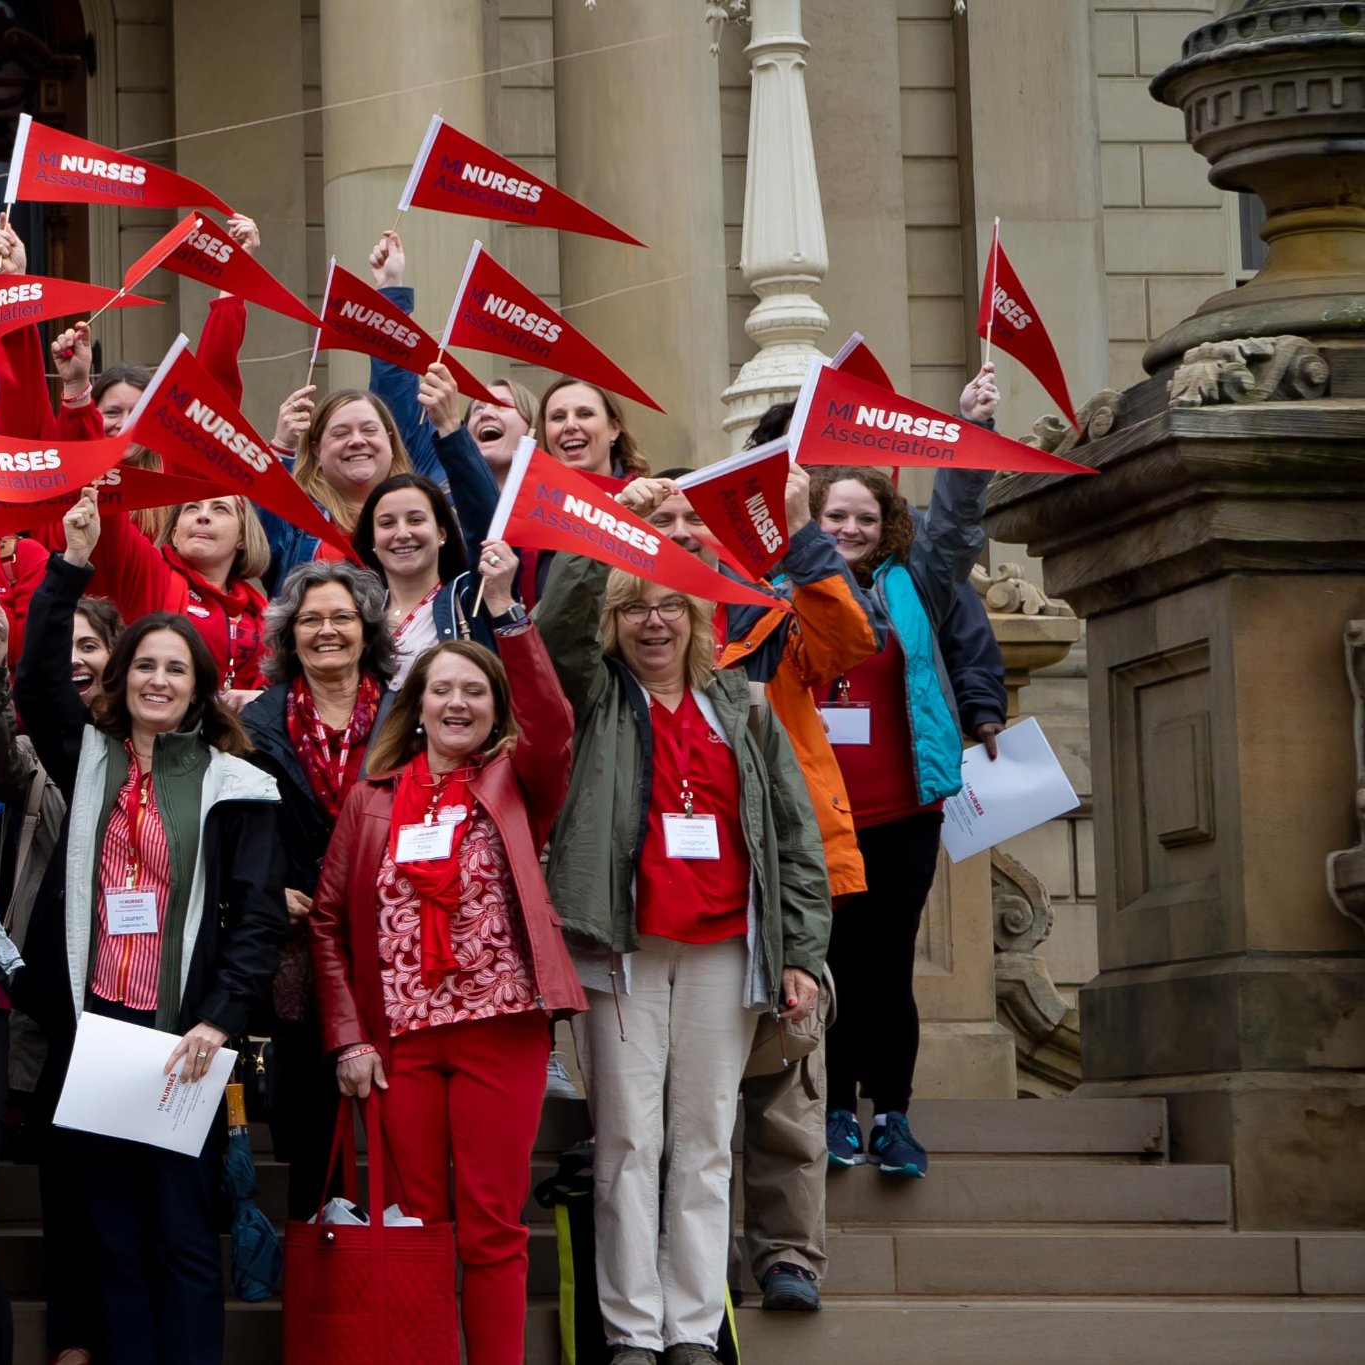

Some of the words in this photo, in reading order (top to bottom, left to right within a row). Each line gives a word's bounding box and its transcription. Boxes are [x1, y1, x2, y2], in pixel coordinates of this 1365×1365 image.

[59, 154, 147, 185] NURSES
[461, 163, 543, 203] NURSES
[185, 229, 234, 263] RSES
[339, 300, 422, 348] NURSES
[483, 294, 563, 344] NURSES
[994, 286, 1033, 330] RSES
[185, 398, 273, 474] NURSES
[855, 405, 962, 443] NURSES
[562, 494, 661, 557] NURSES
[744, 492, 783, 554] NURSES
[121, 914, 145, 922] Lauren
[160, 1073, 177, 1103] NURSES
